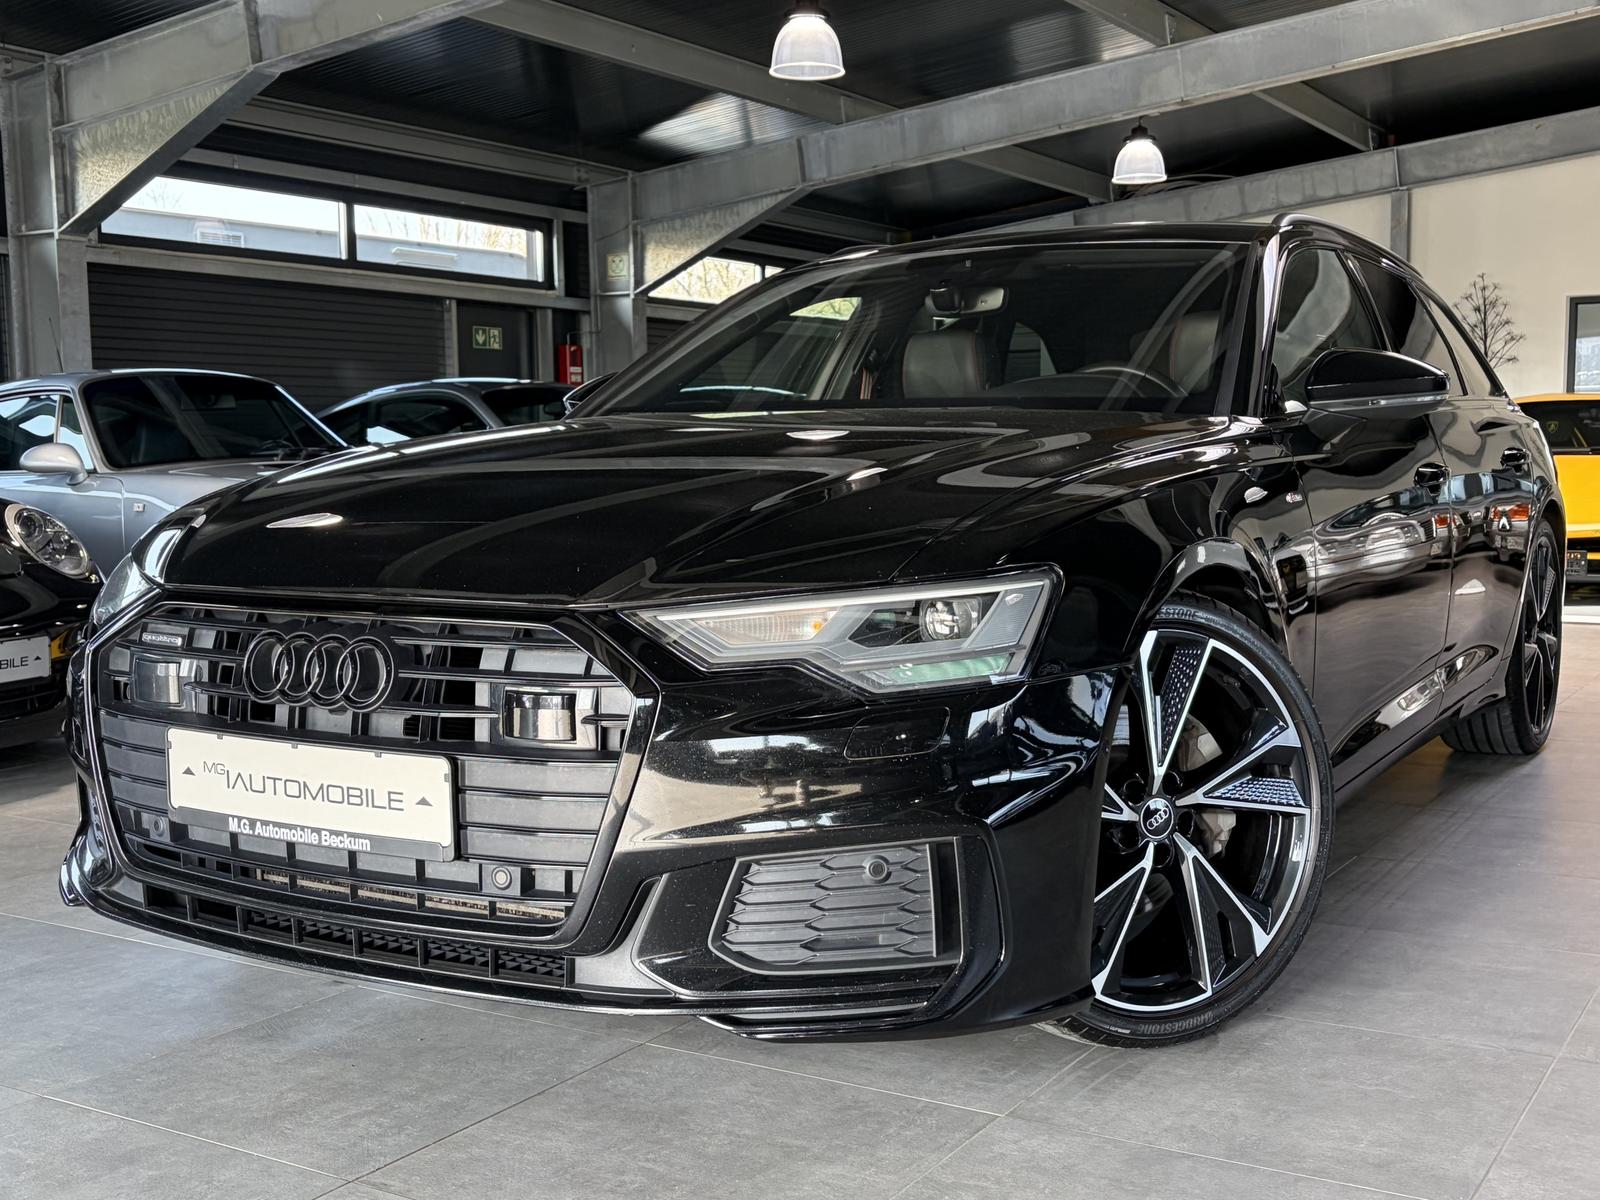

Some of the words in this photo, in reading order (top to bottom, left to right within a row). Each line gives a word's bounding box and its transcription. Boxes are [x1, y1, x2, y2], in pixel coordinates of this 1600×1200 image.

[203, 760, 226, 775] MG
[228, 816, 253, 835] M.G.
[254, 820, 319, 845] Automobile
[321, 830, 371, 851] Beckum
